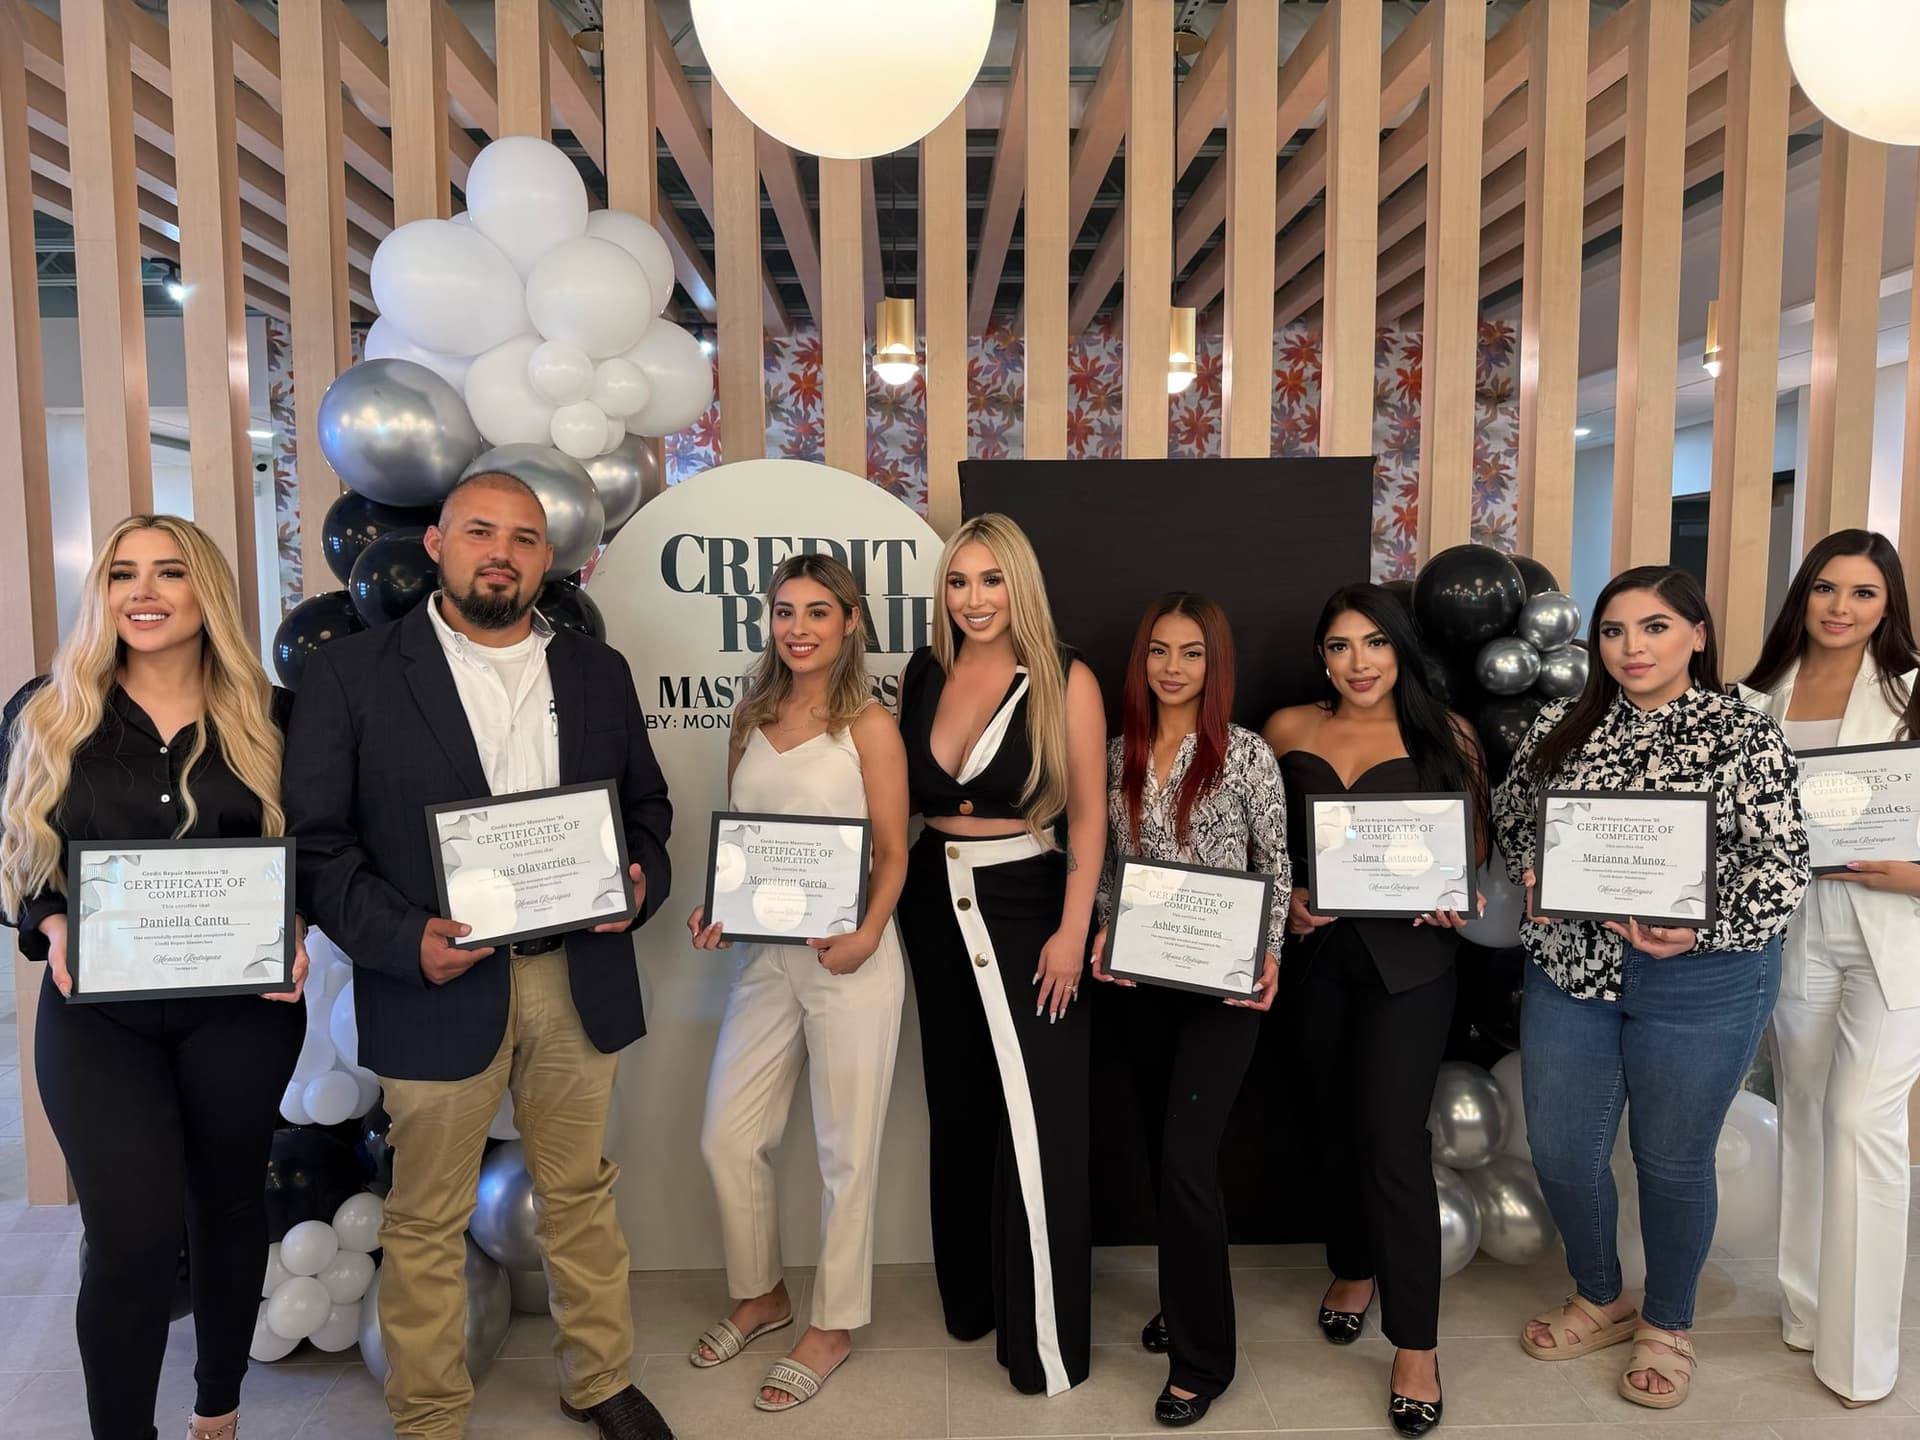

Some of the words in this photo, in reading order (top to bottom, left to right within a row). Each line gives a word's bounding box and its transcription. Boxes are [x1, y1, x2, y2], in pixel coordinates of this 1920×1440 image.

[718, 596, 934, 654] RAI
[645, 714, 677, 729] BY:
[683, 714, 732, 729] MON
[1886, 773, 1912, 782] OF
[477, 823, 561, 845] CERTIFICATE
[564, 820, 580, 831] OF
[1345, 824, 1416, 833] ERTIFICATE
[1419, 824, 1435, 832] OF
[1577, 823, 1655, 833] CERTIFICATE
[1658, 825, 1675, 834] OF
[500, 833, 566, 850] COMPLETION
[1595, 833, 1658, 841] COMPLETION
[747, 845, 817, 857] CERTIFICATE
[819, 849, 834, 858] OF
[763, 855, 820, 865] COMPLETION
[1583, 853, 1629, 864] Marianna
[1632, 855, 1666, 866] Munoz
[493, 865, 515, 878] Luis
[518, 856, 576, 874] Olavarrieta
[123, 878, 222, 890] CERTIFICATE
[226, 877, 247, 887] OF
[799, 878, 827, 889] Garcia
[148, 889, 227, 899] COMPLETION
[1164, 901, 1219, 915] COMPLETION
[1219, 900, 1234, 909] OF
[140, 916, 190, 929] Daniella
[194, 915, 229, 927] Cantu
[1152, 920, 1181, 933] Ashley
[1182, 924, 1222, 939] Sifuentes
